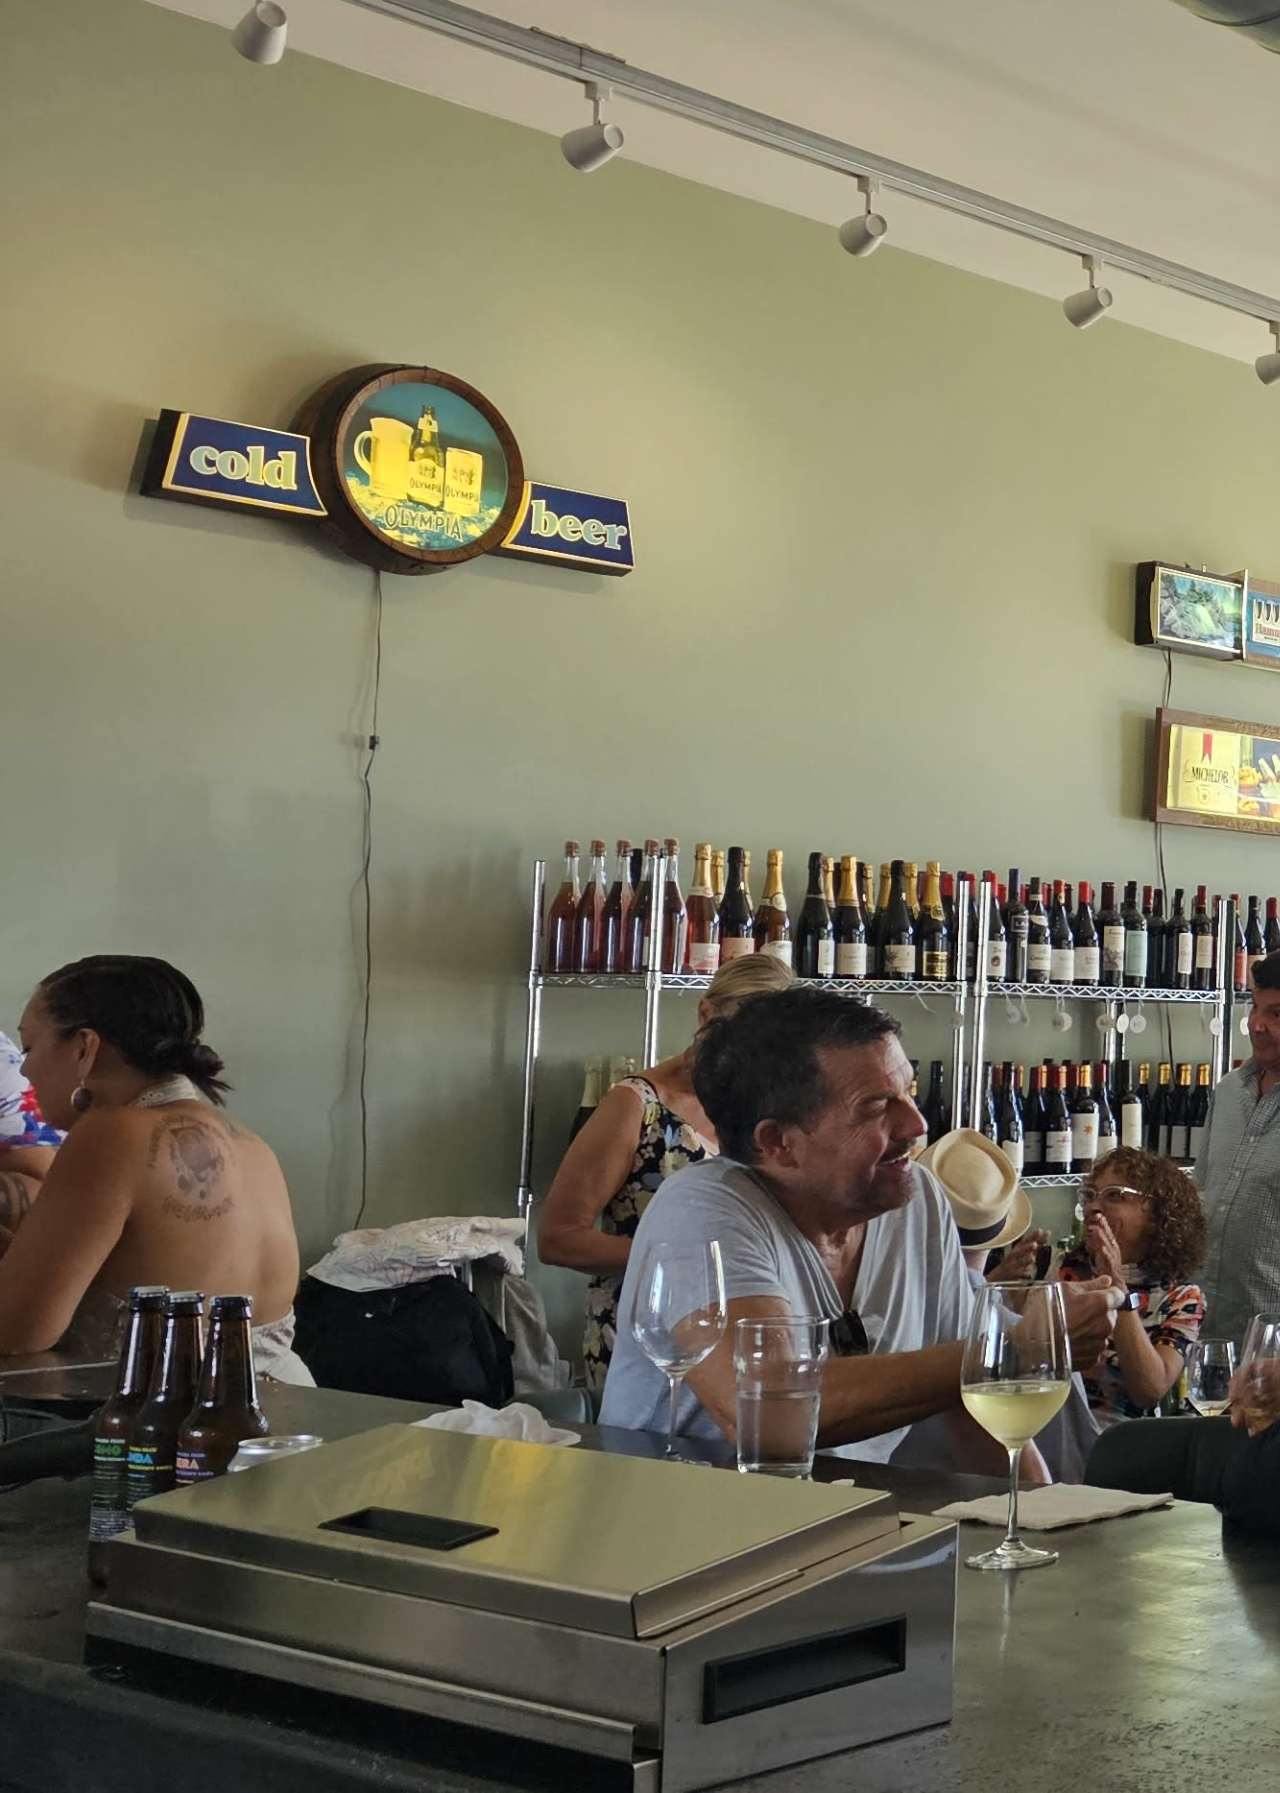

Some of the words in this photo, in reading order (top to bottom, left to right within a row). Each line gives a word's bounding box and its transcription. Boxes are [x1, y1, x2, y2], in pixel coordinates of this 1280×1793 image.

[190, 445, 298, 490] cold
[384, 505, 464, 542] OLYMPIA
[531, 499, 628, 551] beer
